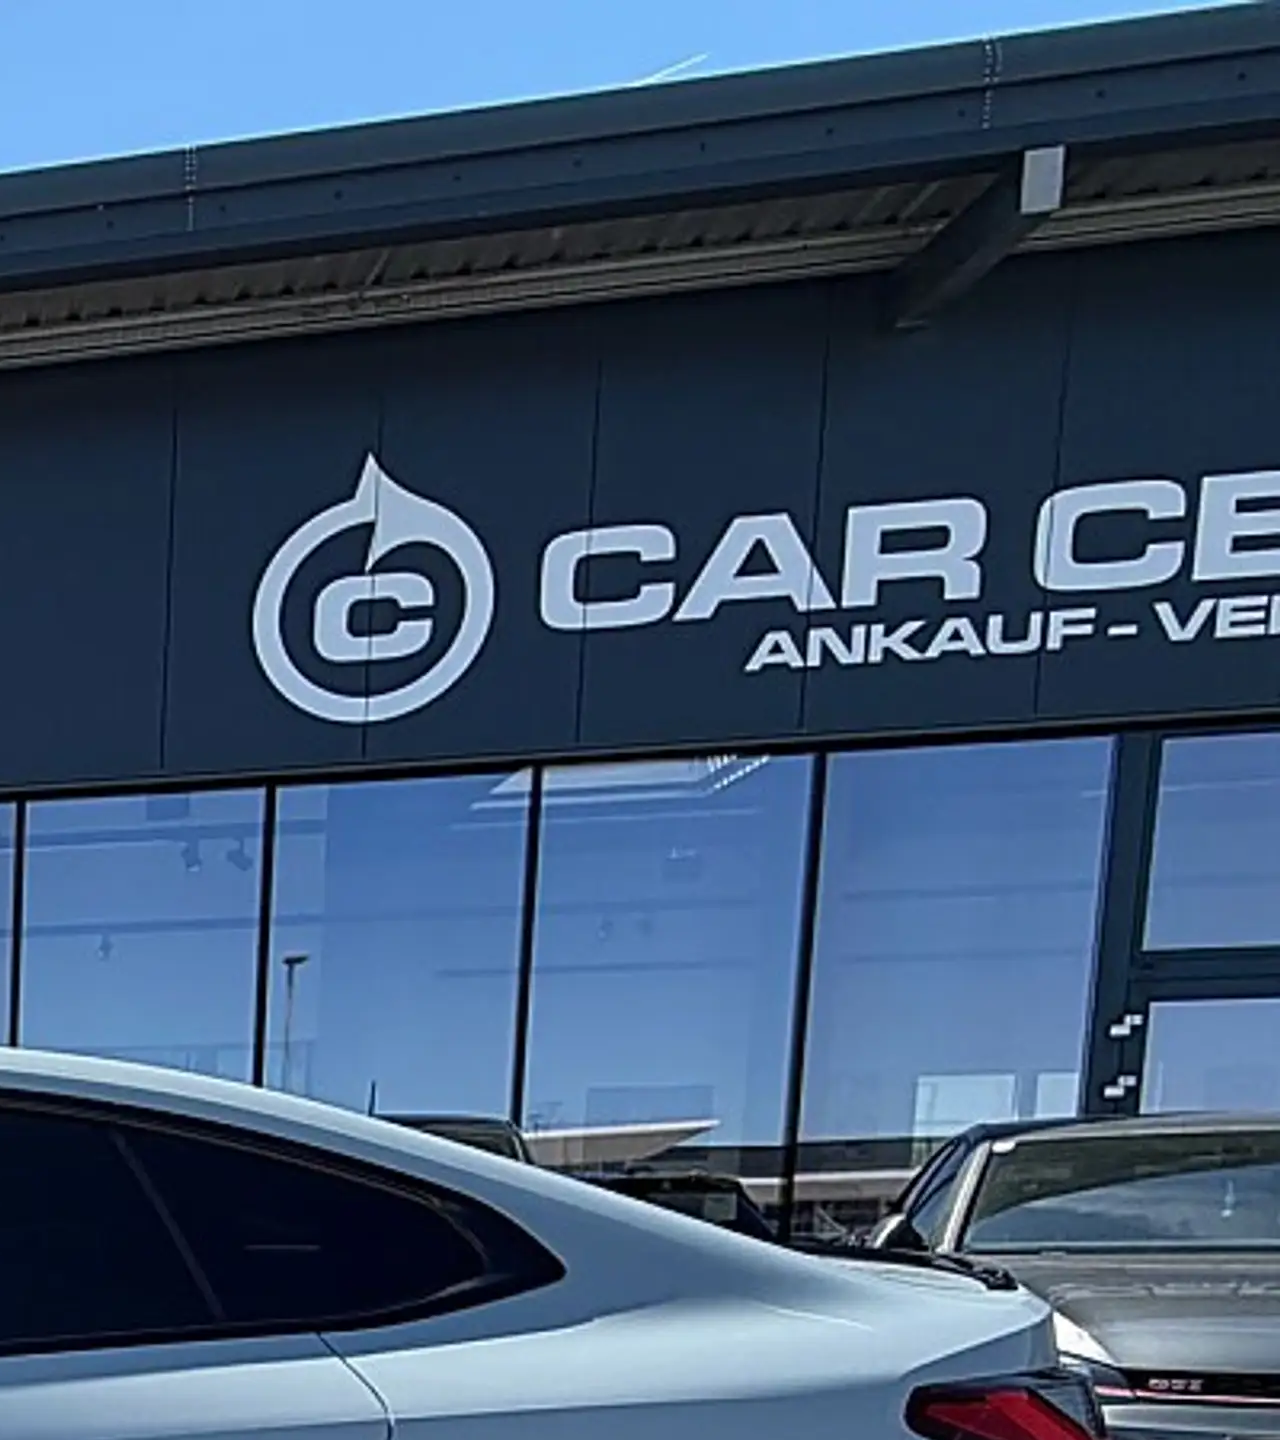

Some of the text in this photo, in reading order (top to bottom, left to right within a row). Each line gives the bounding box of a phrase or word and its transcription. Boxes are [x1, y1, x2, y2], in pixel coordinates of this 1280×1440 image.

[540, 469, 1280, 631] CAR CE
[744, 606, 1097, 672] ANKAUF
[1153, 595, 1280, 642] VE
